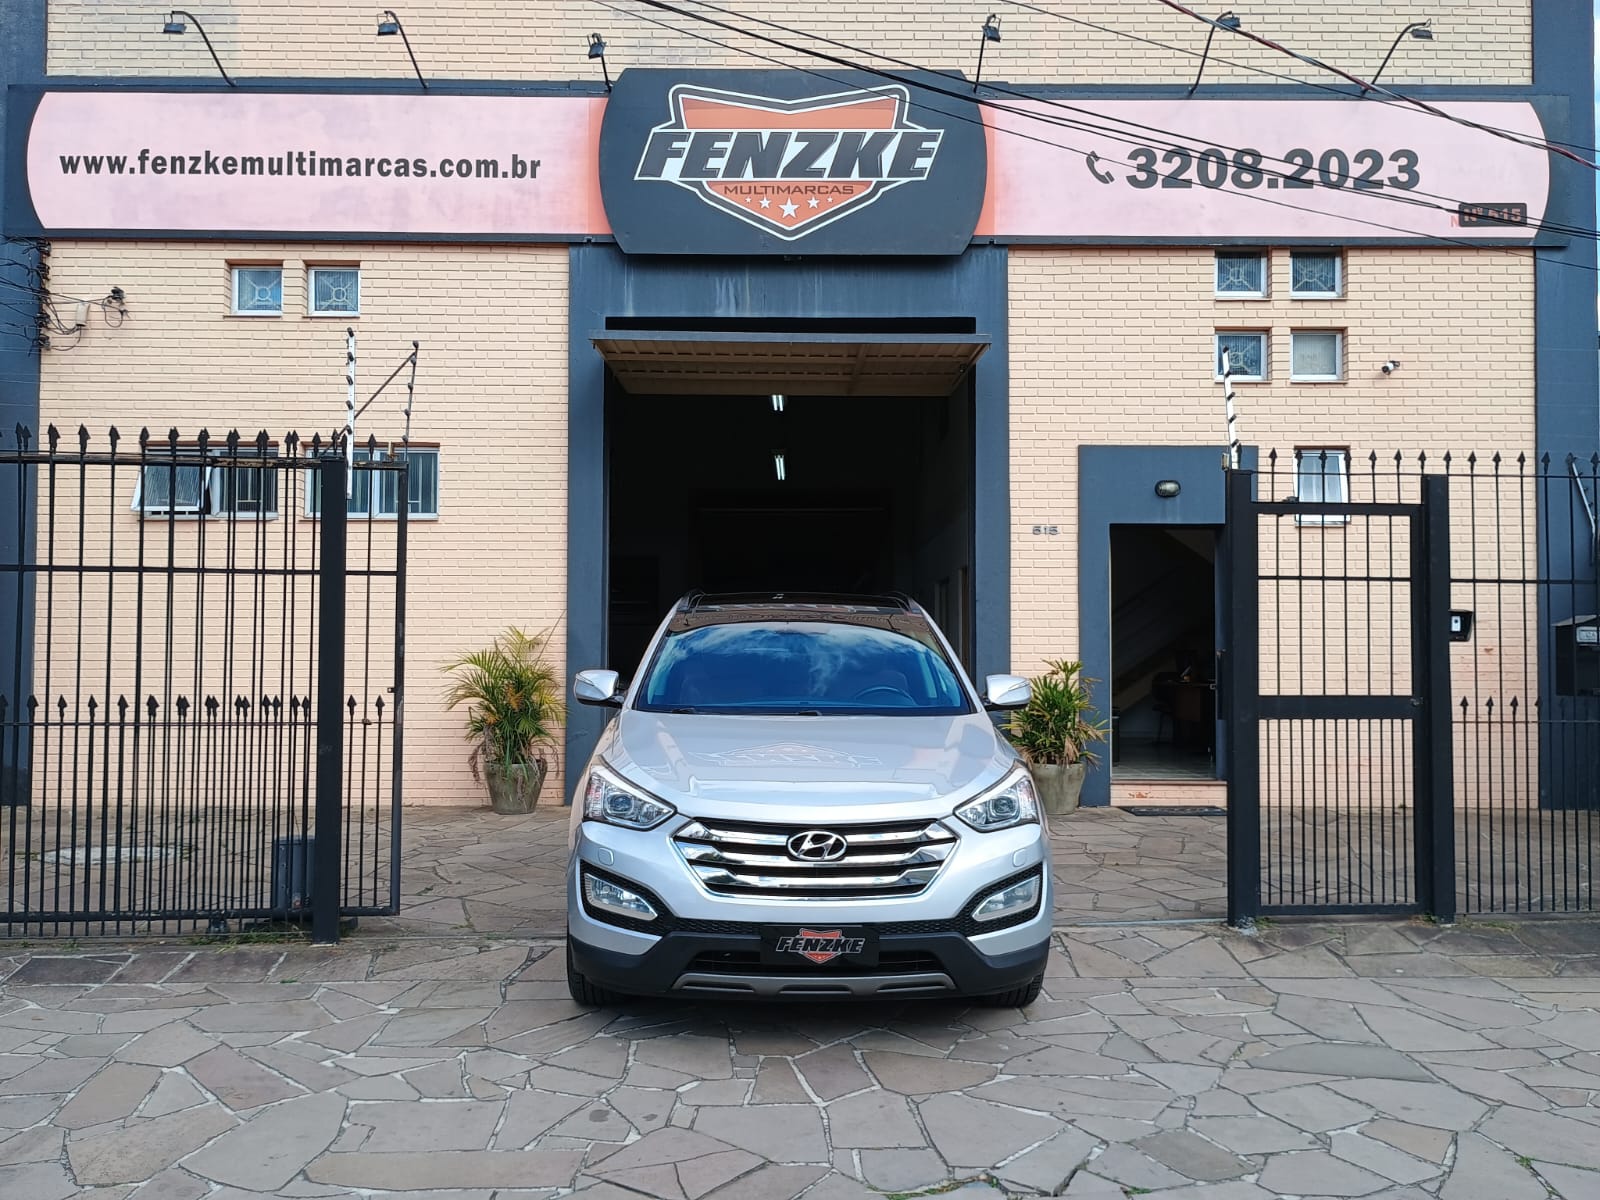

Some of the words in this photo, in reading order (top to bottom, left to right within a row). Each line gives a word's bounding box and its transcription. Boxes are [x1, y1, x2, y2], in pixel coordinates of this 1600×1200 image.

[60, 148, 541, 179] www.fenzkemultimarcas.com.br
[634, 128, 944, 181] FENZKE
[1126, 147, 1420, 190] 3208.2023
[723, 183, 854, 196] MULTIMARCAS
[776, 937, 866, 954] FENZKE
